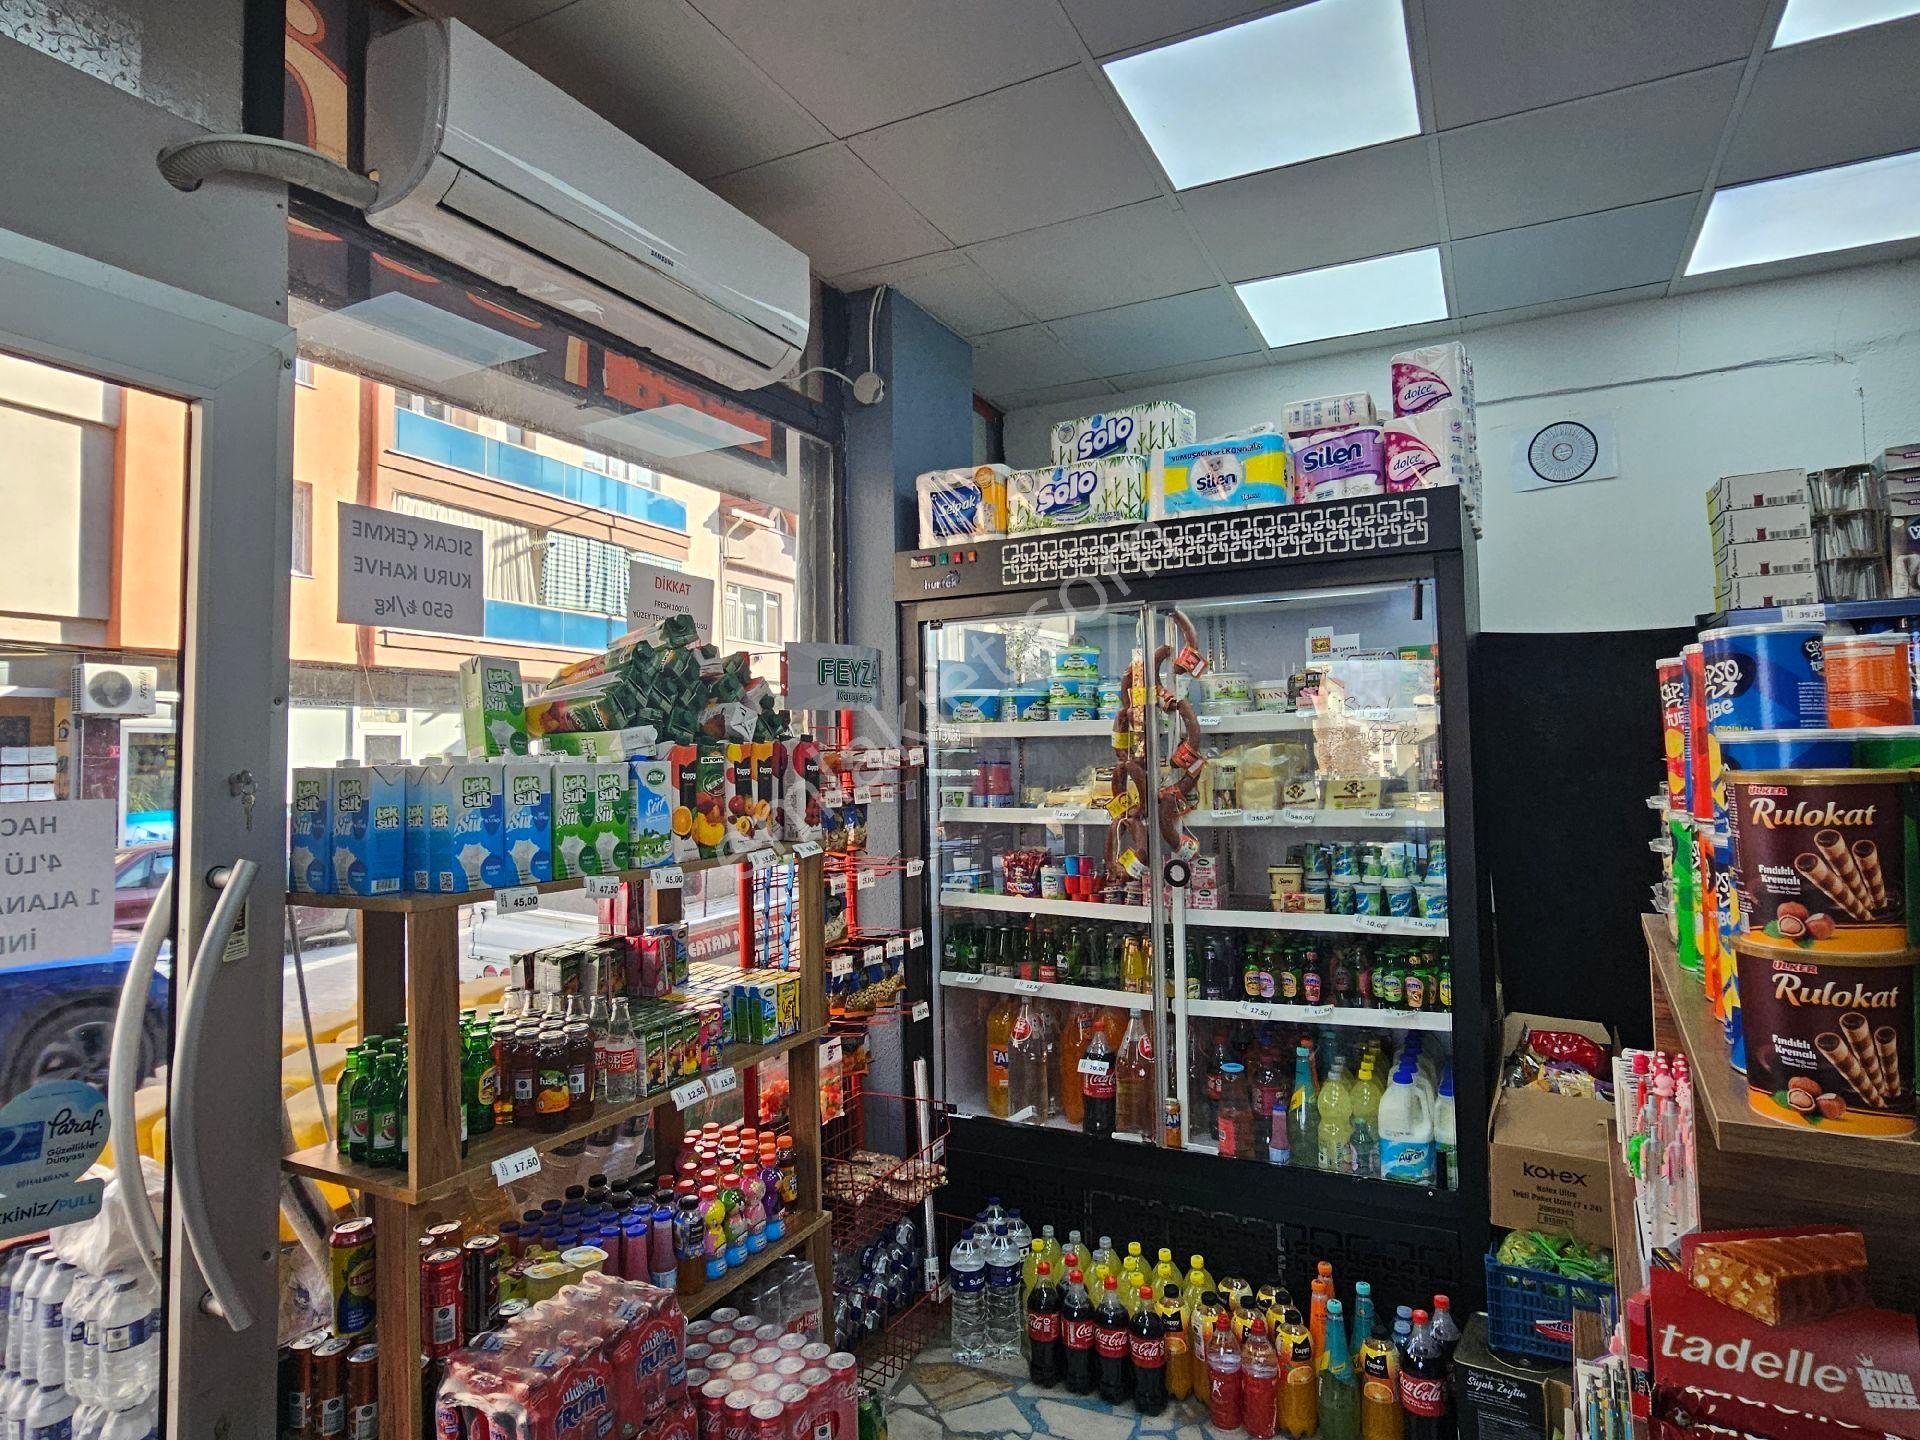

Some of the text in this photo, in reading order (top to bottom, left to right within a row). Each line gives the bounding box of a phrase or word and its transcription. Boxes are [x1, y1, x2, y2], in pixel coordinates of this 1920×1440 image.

[1303, 441, 1363, 473] Silen
[654, 575, 692, 596] DİKKAT
[1748, 785, 1788, 796] ÜLKER
[1750, 797, 1877, 830] Rulokat
[513, 896, 539, 908] 45,00
[1772, 960, 1818, 975] ÜLKER
[1772, 973, 1899, 1009] Rulokat
[687, 1086, 706, 1101] 12,50
[46, 1141, 100, 1157] Güzellikler
[46, 1153, 85, 1166] Dünyası
[514, 1156, 539, 1174] 17,50
[1660, 1324, 1848, 1394] tadelle
[1466, 1376, 1529, 1400] Siyah Zeytin
[1856, 1367, 1915, 1396] KING
